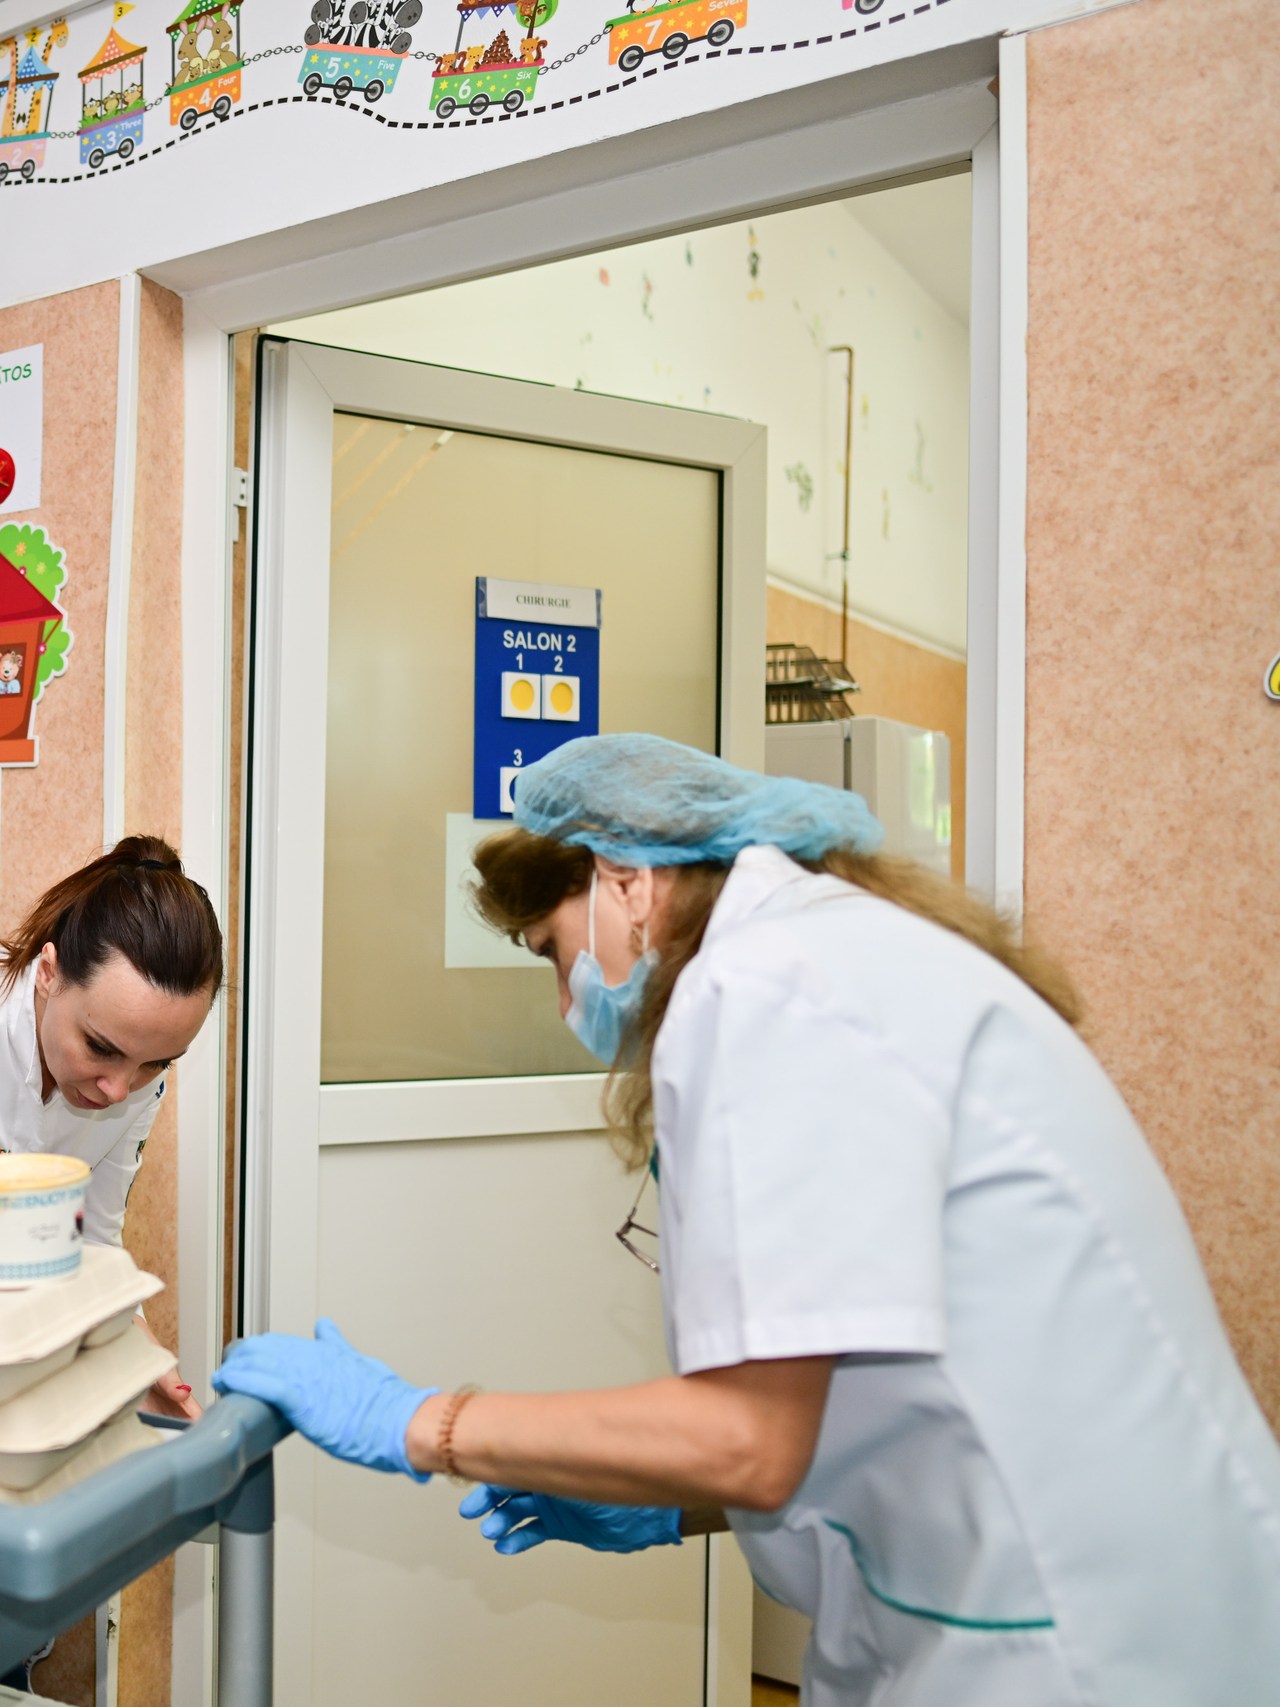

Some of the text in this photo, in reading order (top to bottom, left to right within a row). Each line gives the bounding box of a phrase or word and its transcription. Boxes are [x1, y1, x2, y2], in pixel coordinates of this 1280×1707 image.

[644, 19, 663, 45] 7
[325, 57, 341, 78] 5
[377, 59, 395, 70] Five
[218, 75, 237, 88] Four
[516, 70, 532, 80] Six
[458, 78, 471, 99] 6
[199, 88, 211, 107] 4
[120, 118, 142, 131] Three
[106, 131, 117, 149] 3
[12, 148, 22, 165] 2
[516, 594, 571, 609] CHIRURGIE
[503, 630, 577, 652] SALON 2
[515, 653, 564, 672] 1 2
[513, 749, 523, 766] 3
